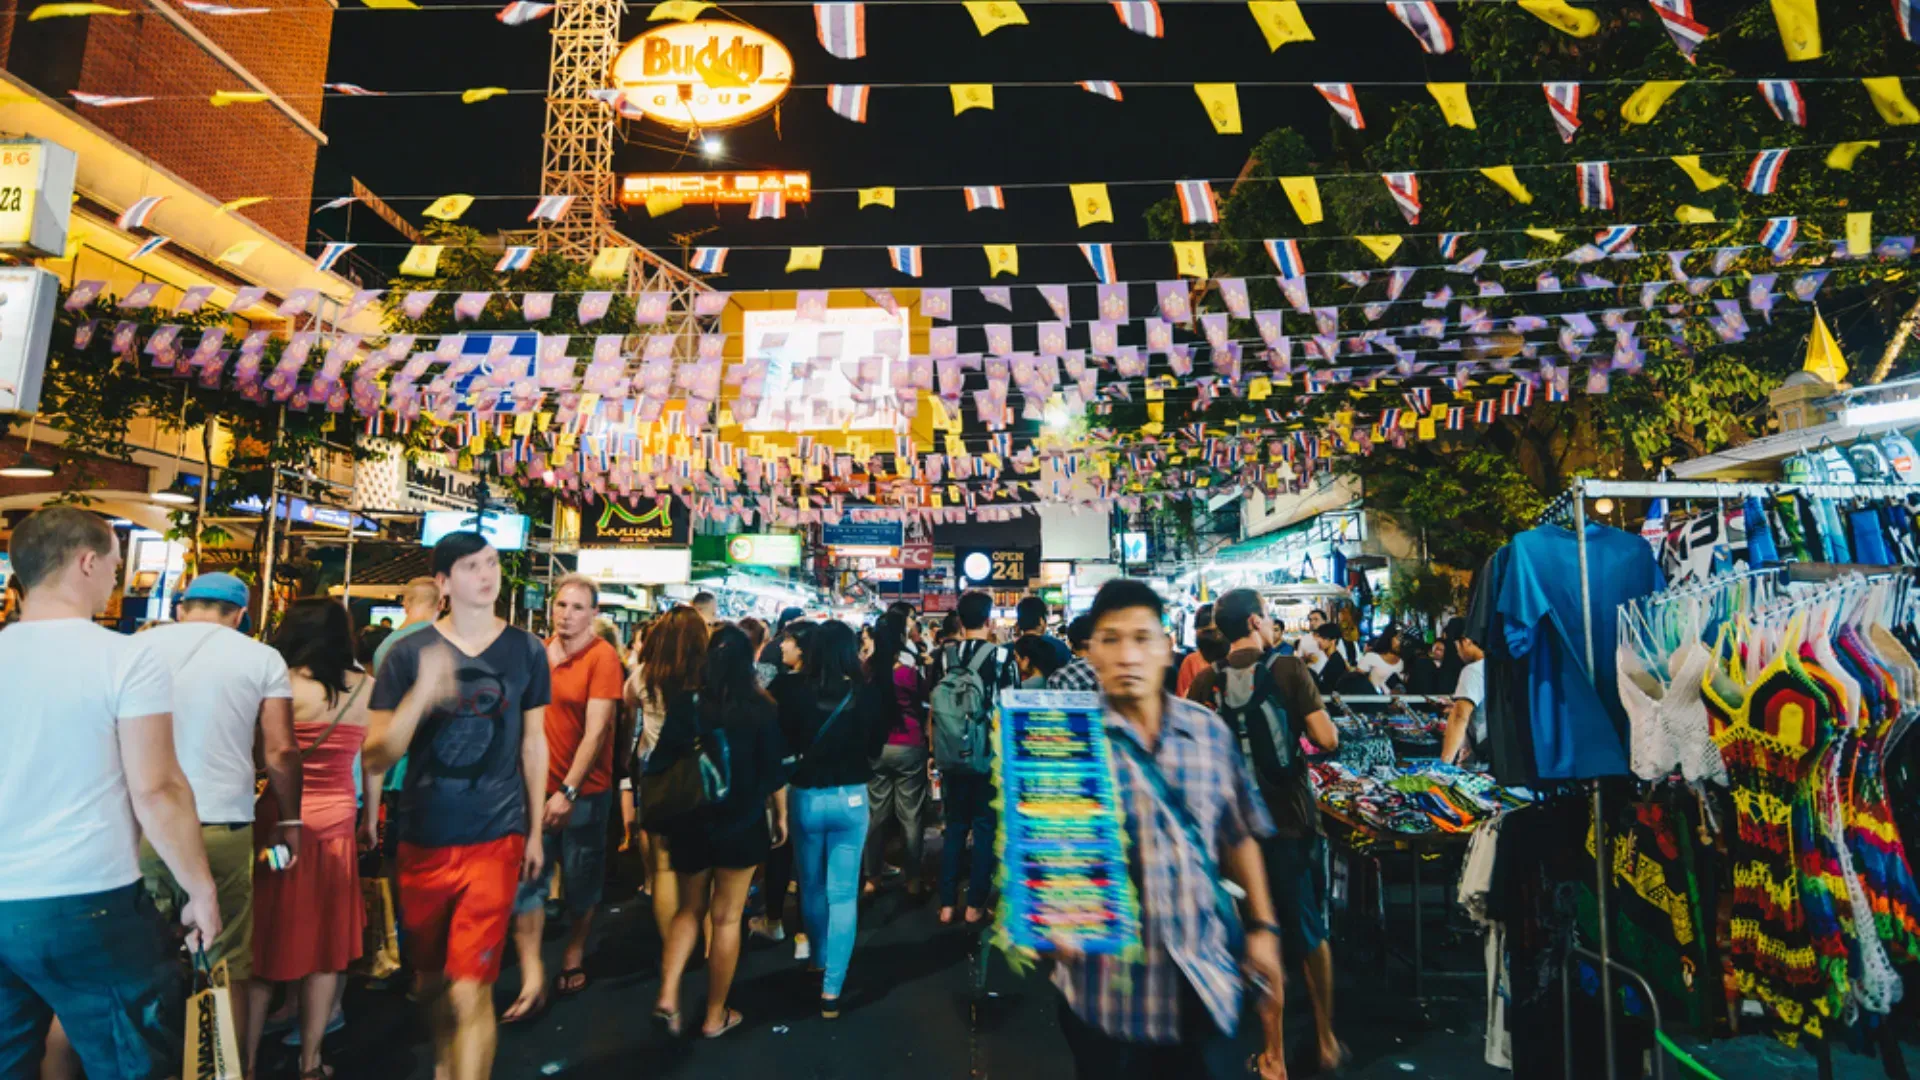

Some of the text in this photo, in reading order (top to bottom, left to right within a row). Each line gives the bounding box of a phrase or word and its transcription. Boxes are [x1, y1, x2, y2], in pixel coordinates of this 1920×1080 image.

[643, 36, 763, 83] Buddy
[653, 94, 751, 105] GOUP
[992, 551, 1024, 561] OPEN
